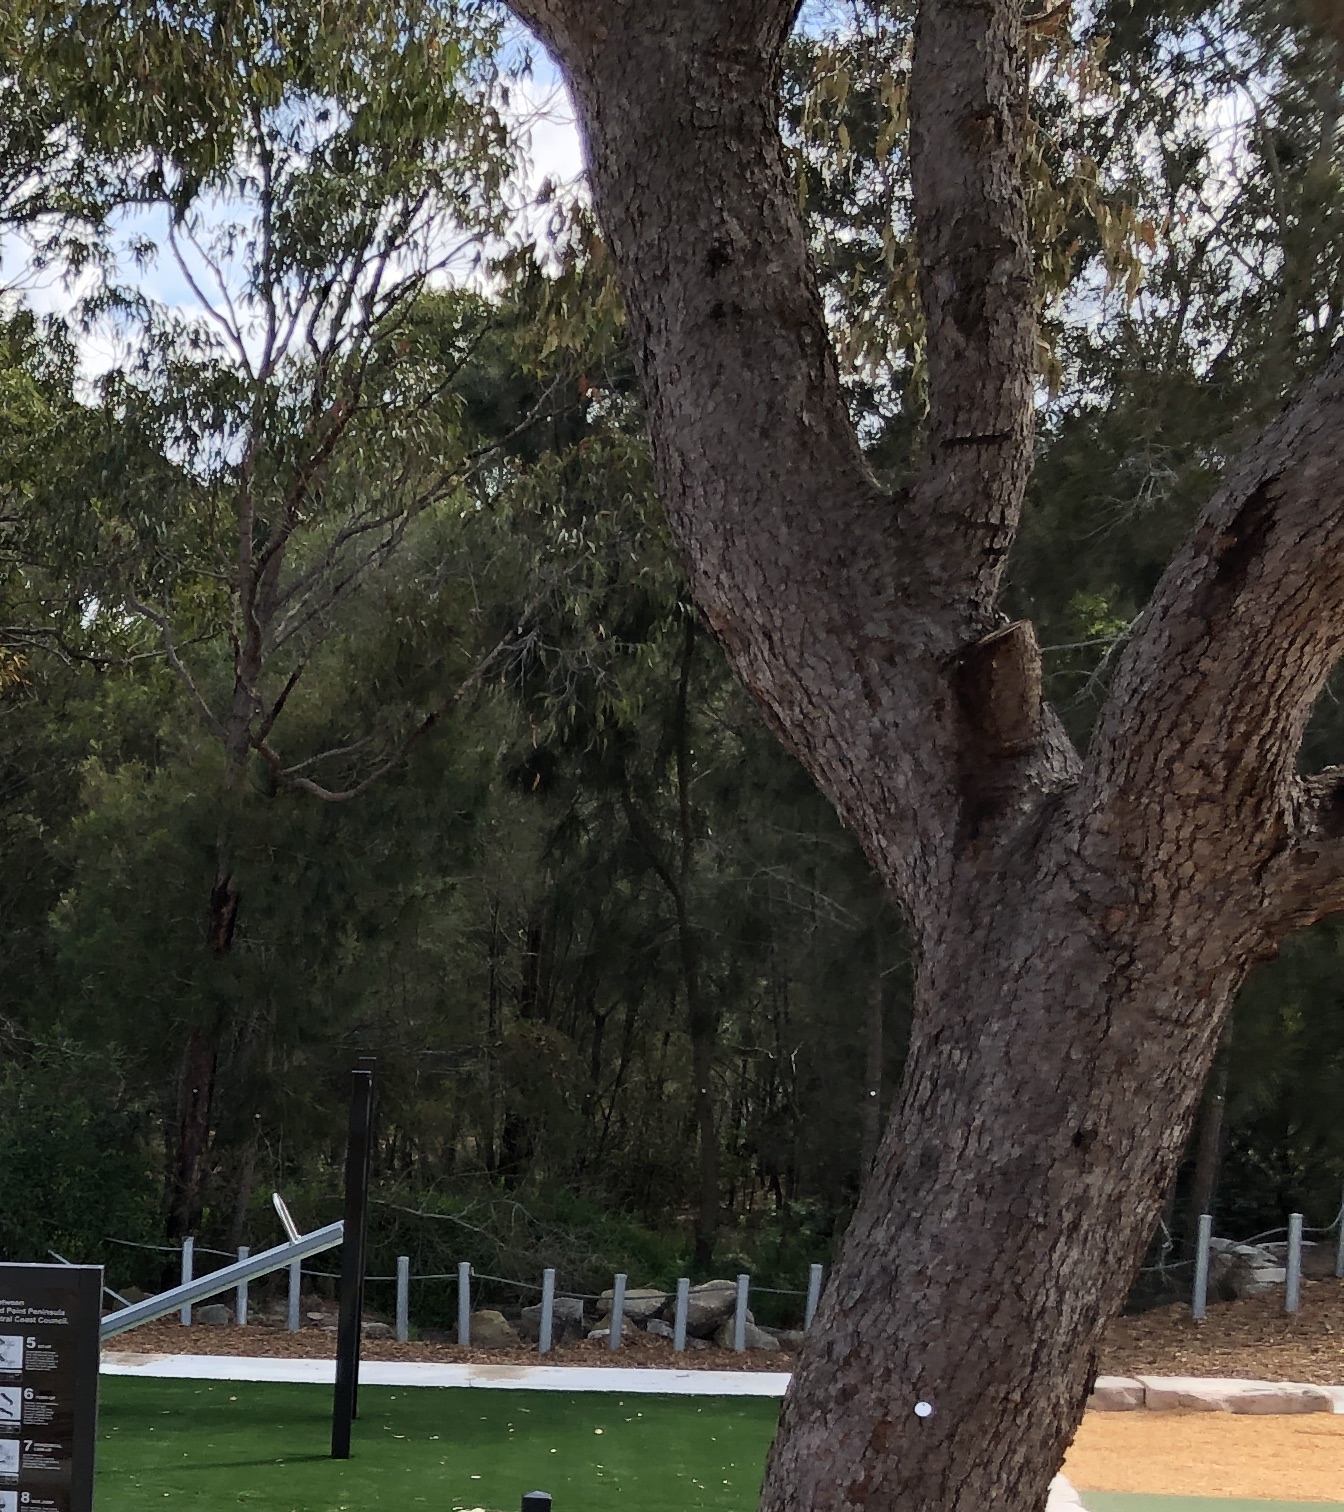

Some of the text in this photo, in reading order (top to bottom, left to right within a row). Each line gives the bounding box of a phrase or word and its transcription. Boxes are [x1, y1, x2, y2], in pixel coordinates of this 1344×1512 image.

[6, 1307, 27, 1315] Point
[14, 1316, 37, 1324] Coast
[26, 1336, 36, 1349] 5
[24, 1388, 34, 1400] 6
[23, 1439, 33, 1452] 7
[21, 1492, 30, 1504] 8
